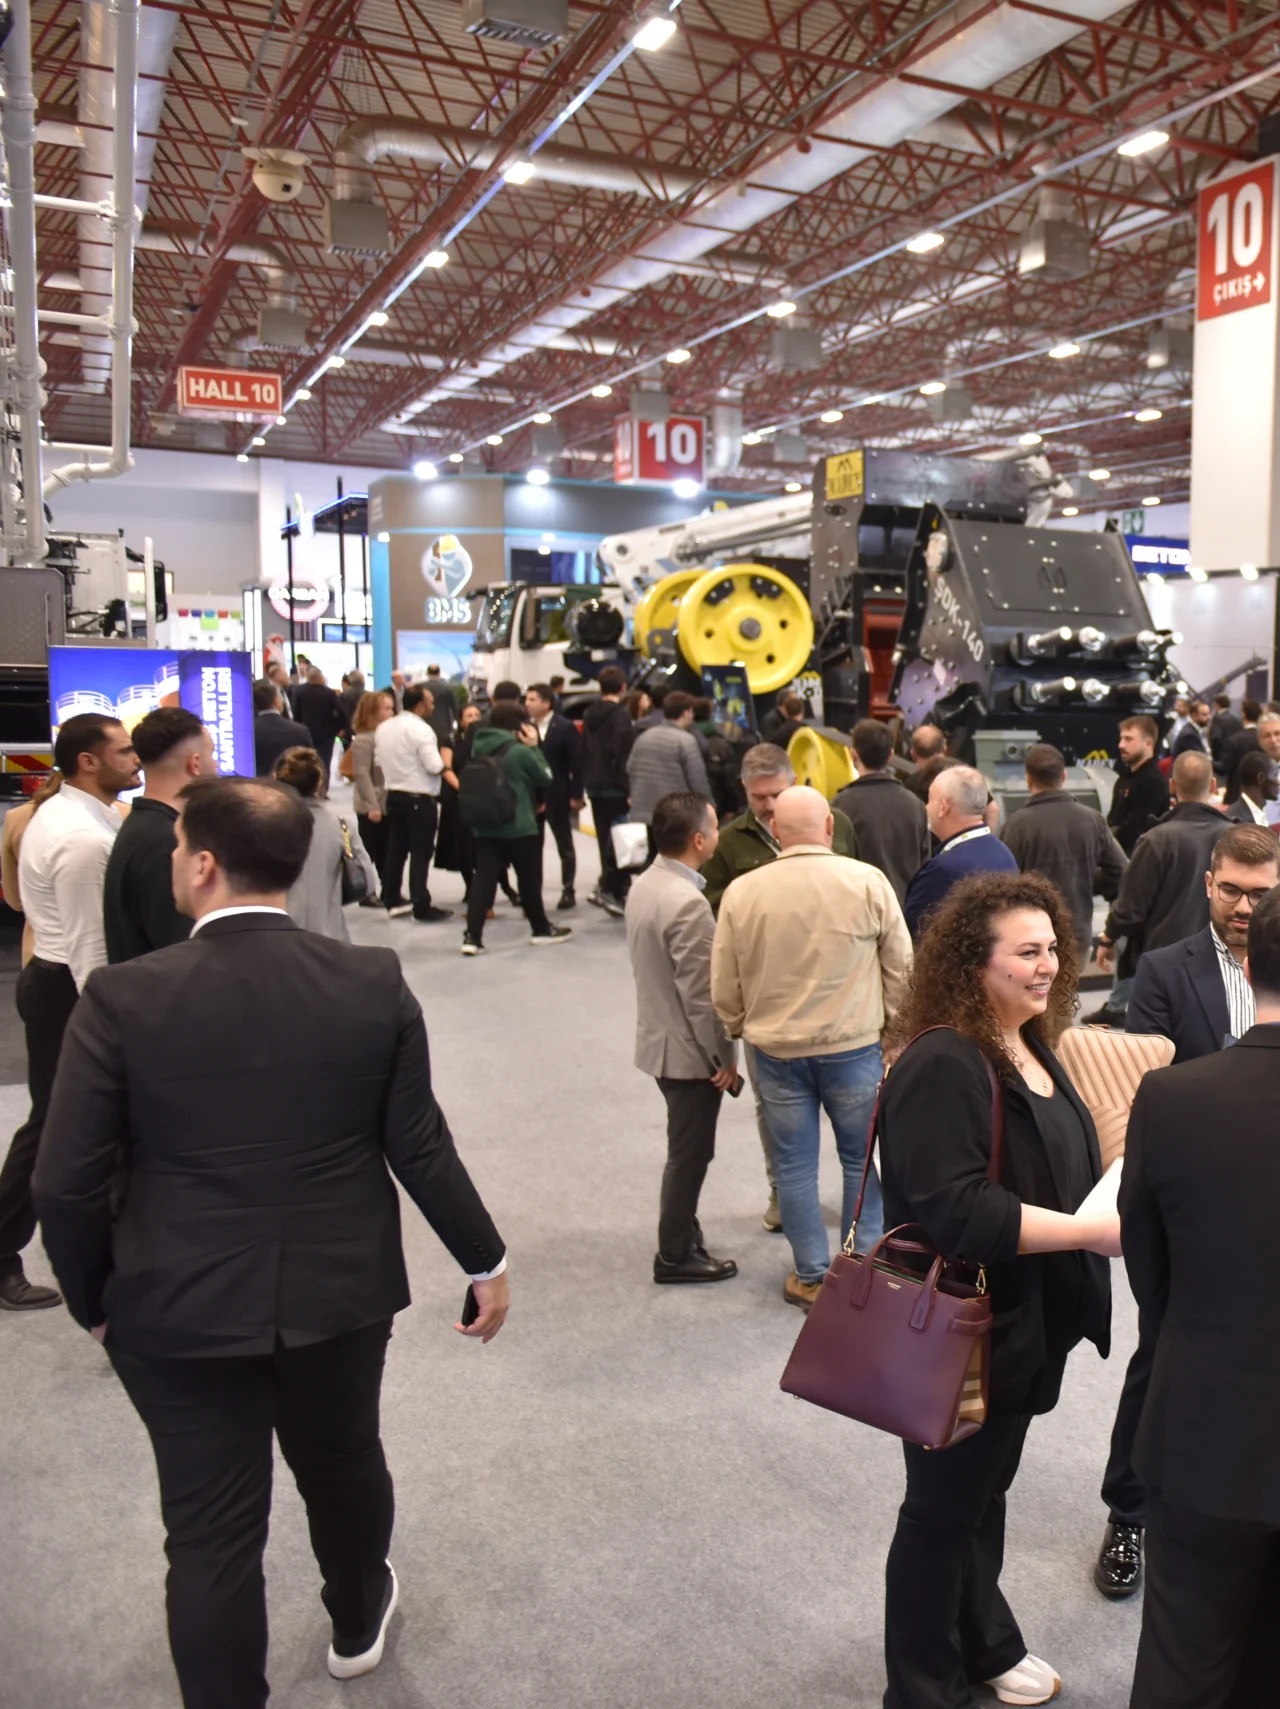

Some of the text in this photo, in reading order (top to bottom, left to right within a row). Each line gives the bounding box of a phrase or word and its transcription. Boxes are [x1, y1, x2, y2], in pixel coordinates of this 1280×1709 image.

[1207, 182, 1264, 276] 10
[1213, 273, 1253, 306] ÇIKIŞ
[189, 377, 275, 404] HALL 10
[647, 421, 697, 465] 10
[424, 596, 472, 625] BMS
